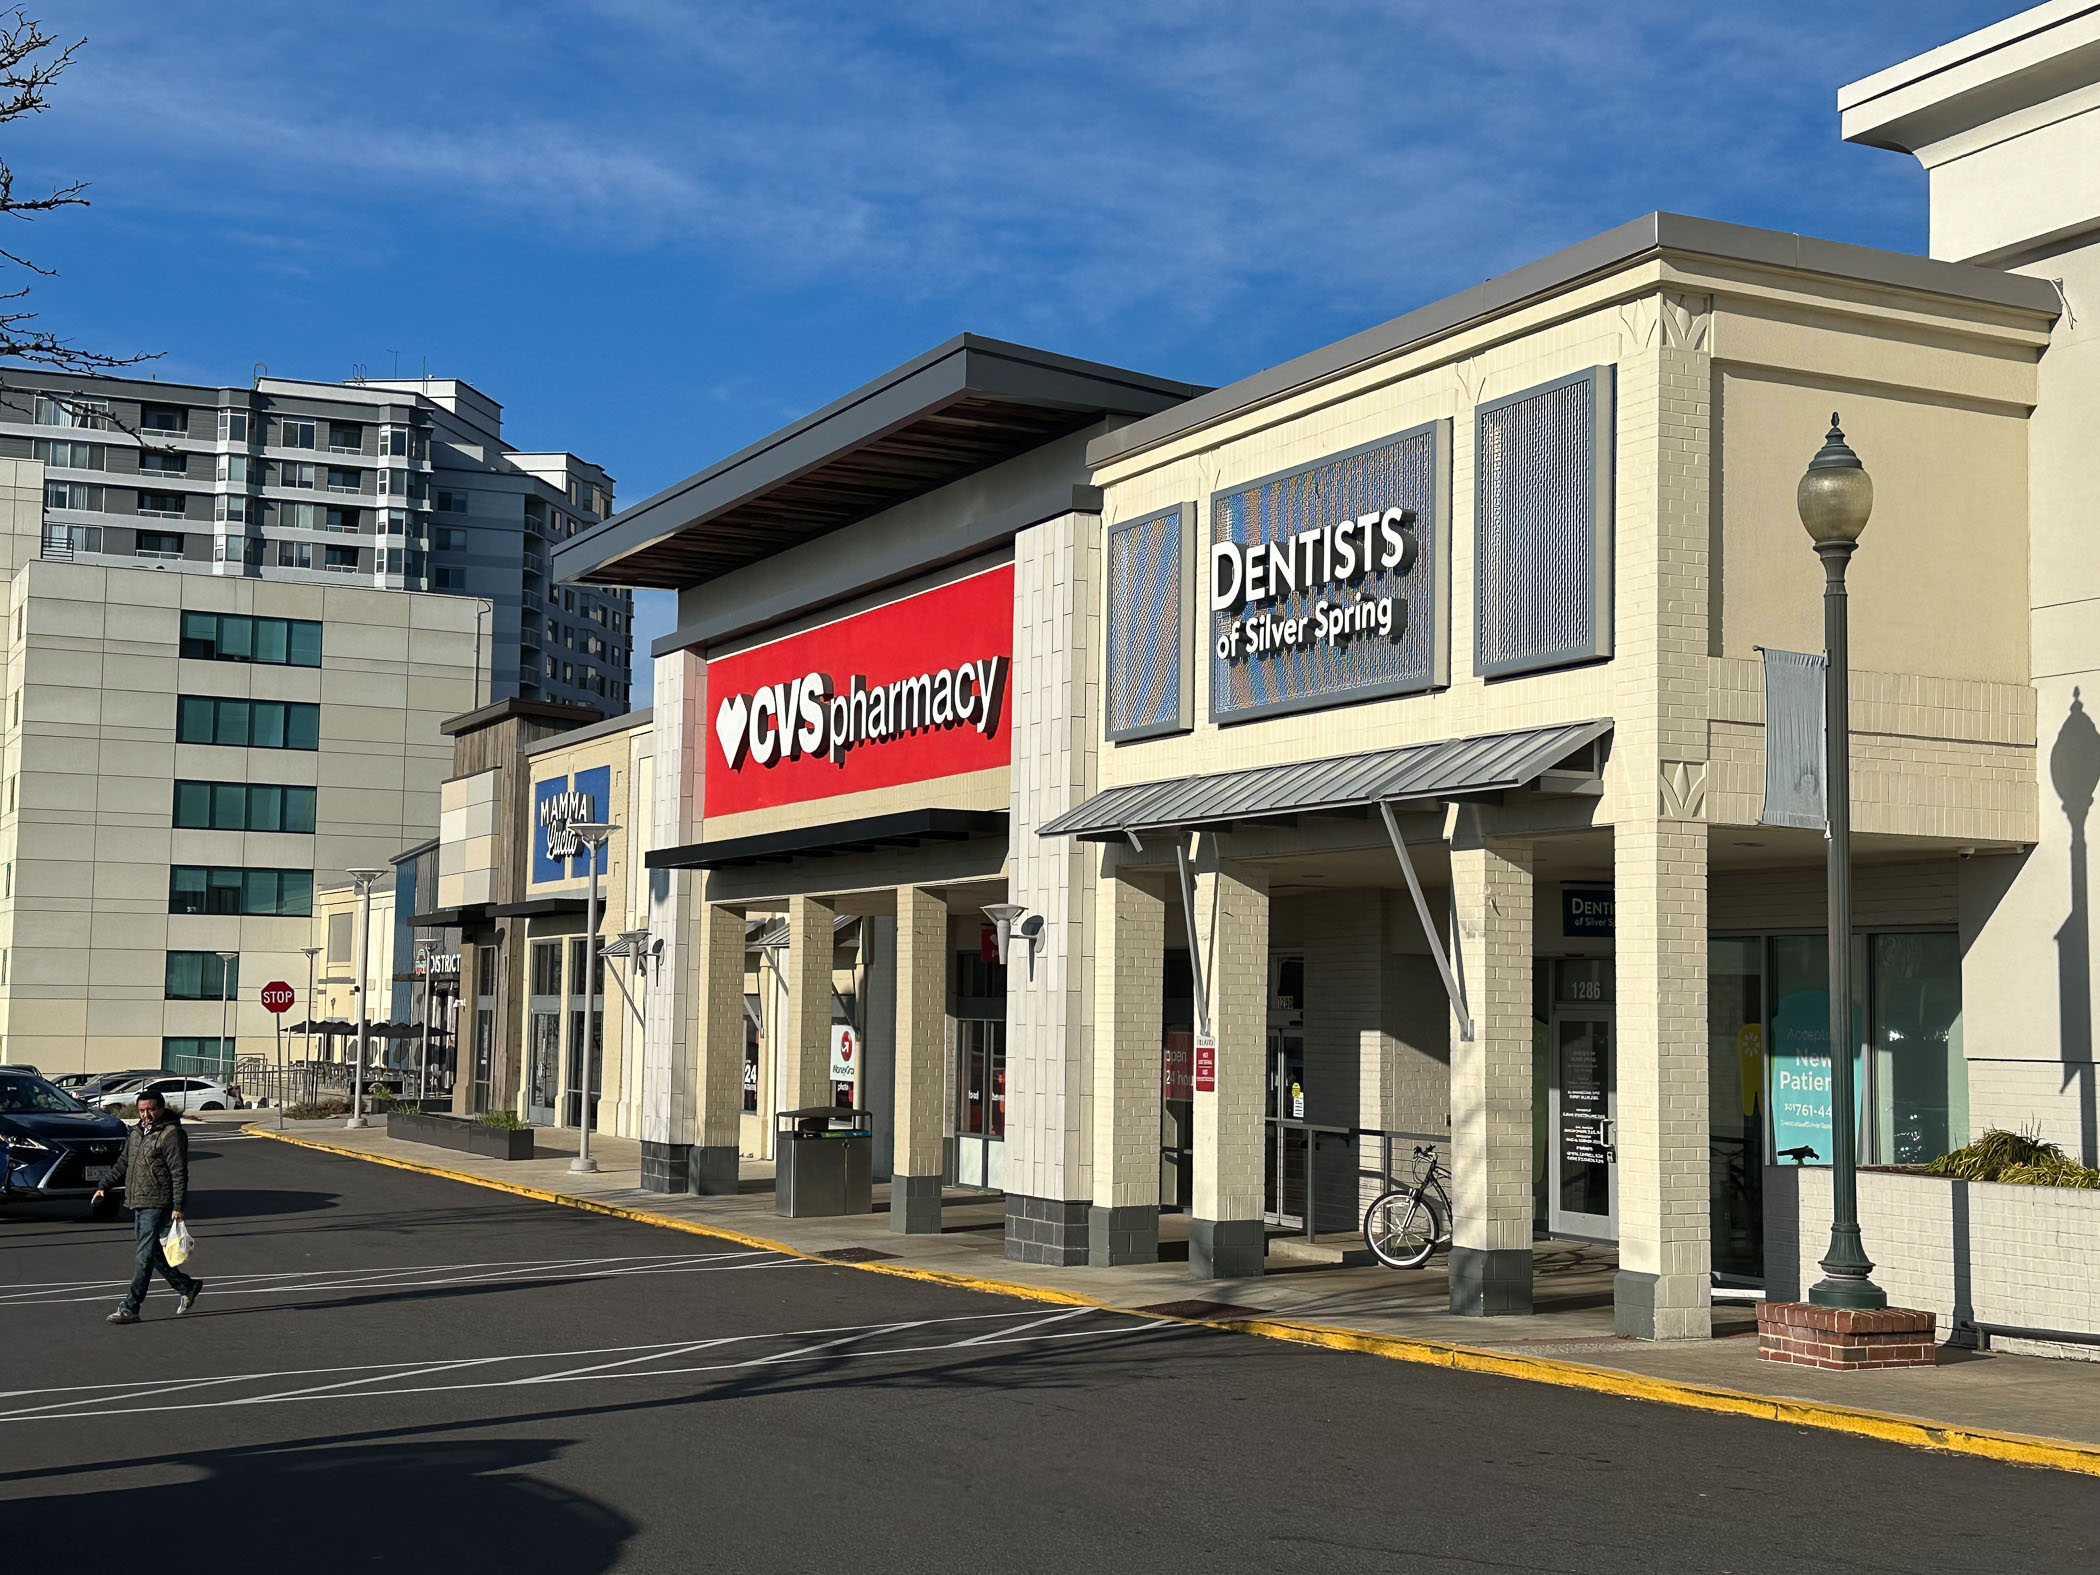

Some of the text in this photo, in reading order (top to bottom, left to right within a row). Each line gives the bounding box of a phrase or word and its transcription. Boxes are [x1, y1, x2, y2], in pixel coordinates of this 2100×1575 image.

[1211, 507, 1404, 612] DENTISTS
[1217, 591, 1393, 659] of Silver Spring
[750, 655, 999, 764] CVS pharmacy
[540, 791, 588, 828] MAMMA
[1571, 898, 1614, 915] DENTI
[1574, 917, 1584, 927] of
[1585, 917, 1606, 927] Silver
[263, 991, 293, 1004] STOP
[1572, 981, 1601, 999] 1286
[743, 1063, 757, 1084] 24
